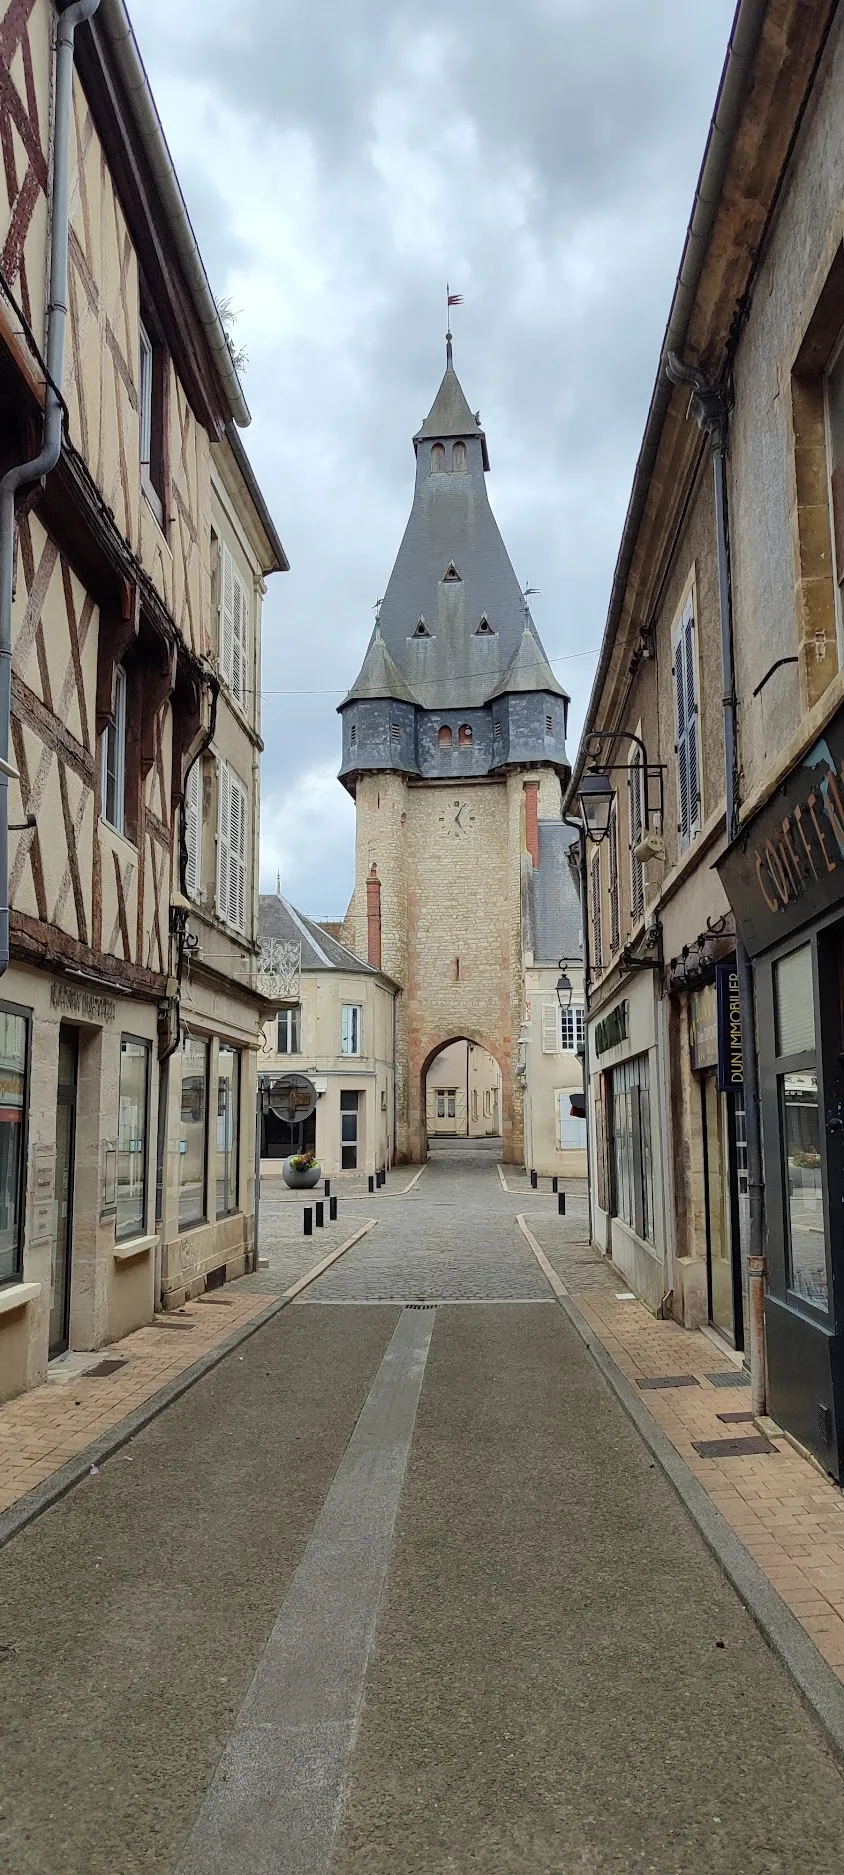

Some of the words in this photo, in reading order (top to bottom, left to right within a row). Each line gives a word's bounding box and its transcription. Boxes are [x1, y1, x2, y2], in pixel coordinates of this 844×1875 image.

[754, 758, 844, 912] COIFFEU
[729, 973, 743, 1048] IMMOBILIER
[731, 1053, 743, 1082] DUN
